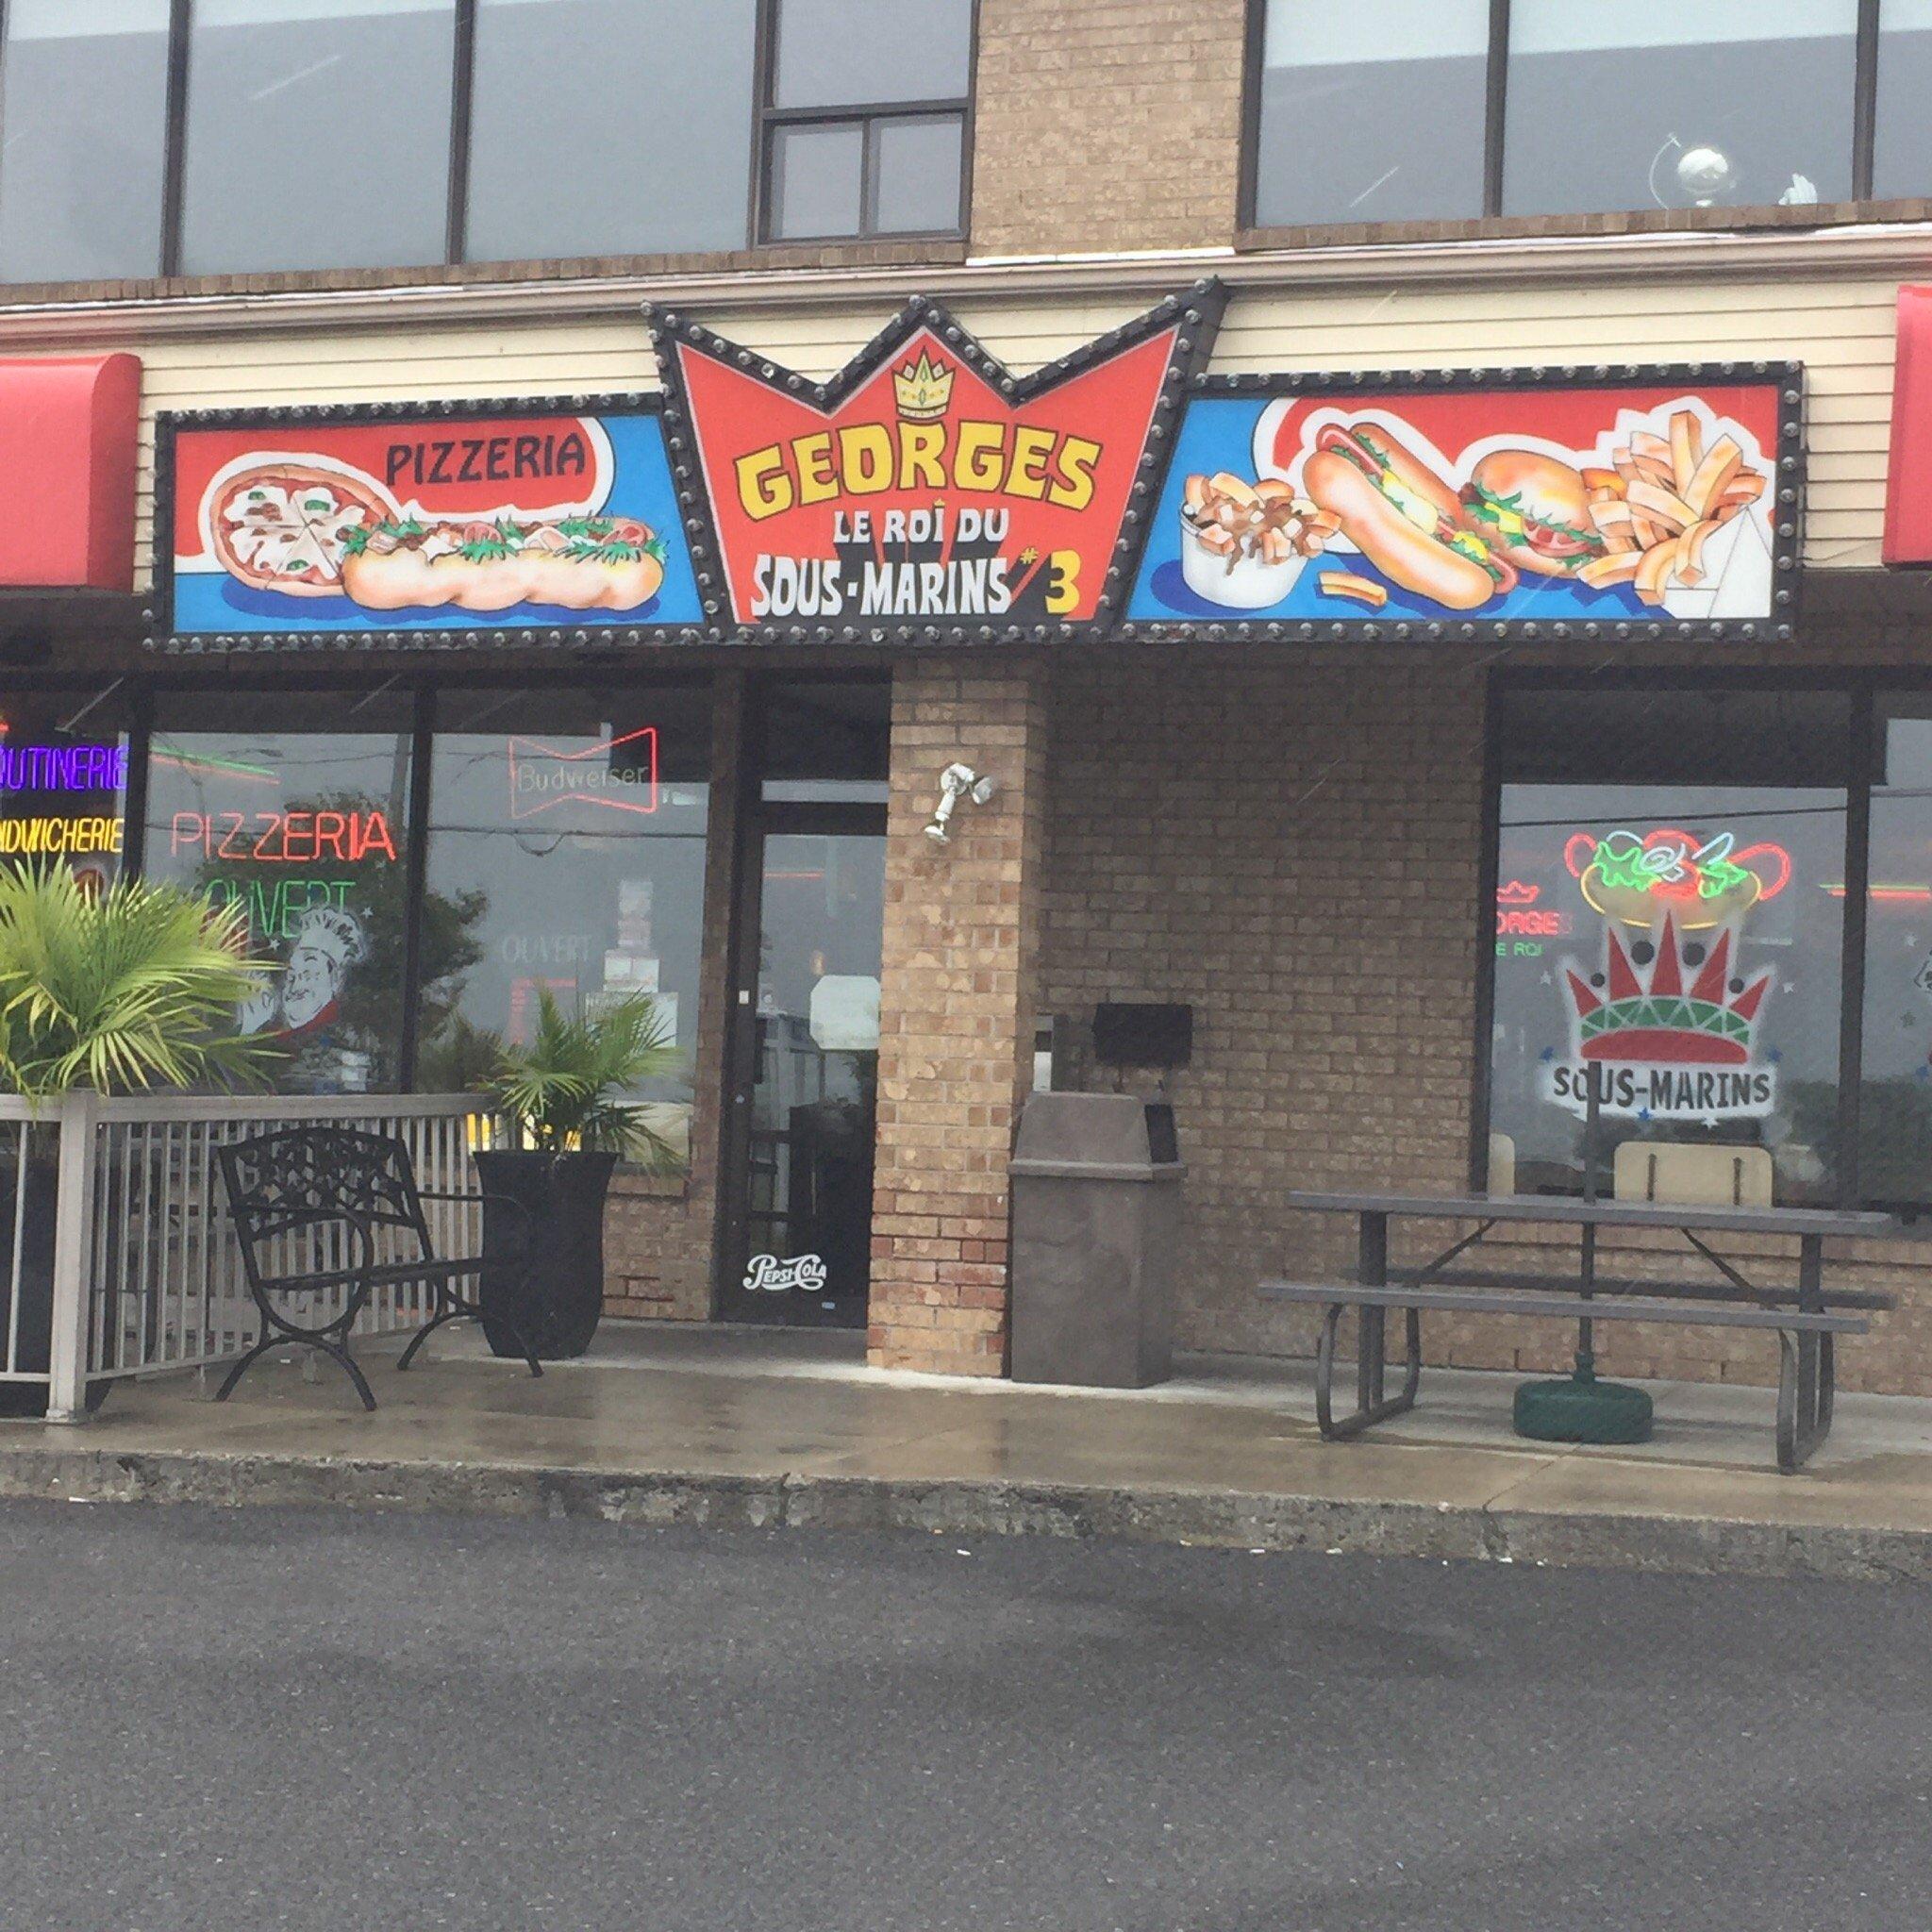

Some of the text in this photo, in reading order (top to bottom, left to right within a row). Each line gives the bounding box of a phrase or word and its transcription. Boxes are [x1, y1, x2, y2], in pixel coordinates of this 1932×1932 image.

[386, 432, 585, 485] PIZZERIA
[732, 419, 1103, 522] GEORGES
[832, 500, 1009, 544] LE ROI DU
[750, 553, 1011, 616] SOUS-MARINS
[518, 764, 649, 792] Budweiser
[171, 812, 396, 860] PIZZERIA
[1554, 1066, 1771, 1110] SOUS-MARINS
